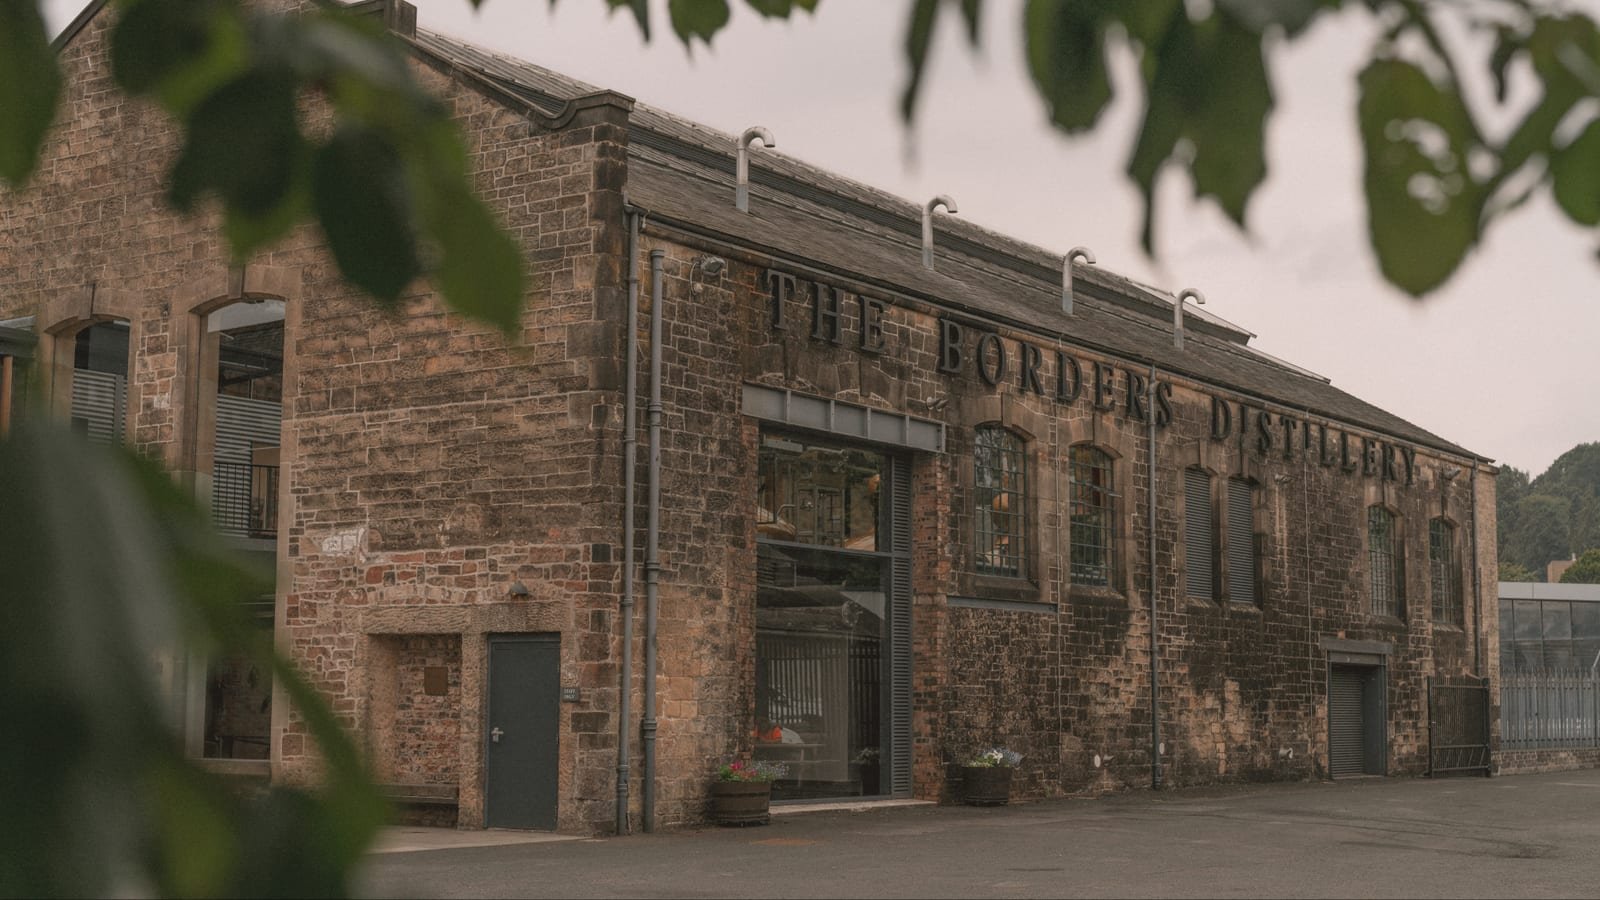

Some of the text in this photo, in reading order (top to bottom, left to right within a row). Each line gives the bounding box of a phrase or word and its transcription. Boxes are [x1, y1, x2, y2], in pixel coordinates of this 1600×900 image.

[767, 269, 1416, 486] THE BORDERS DISTILLERY
